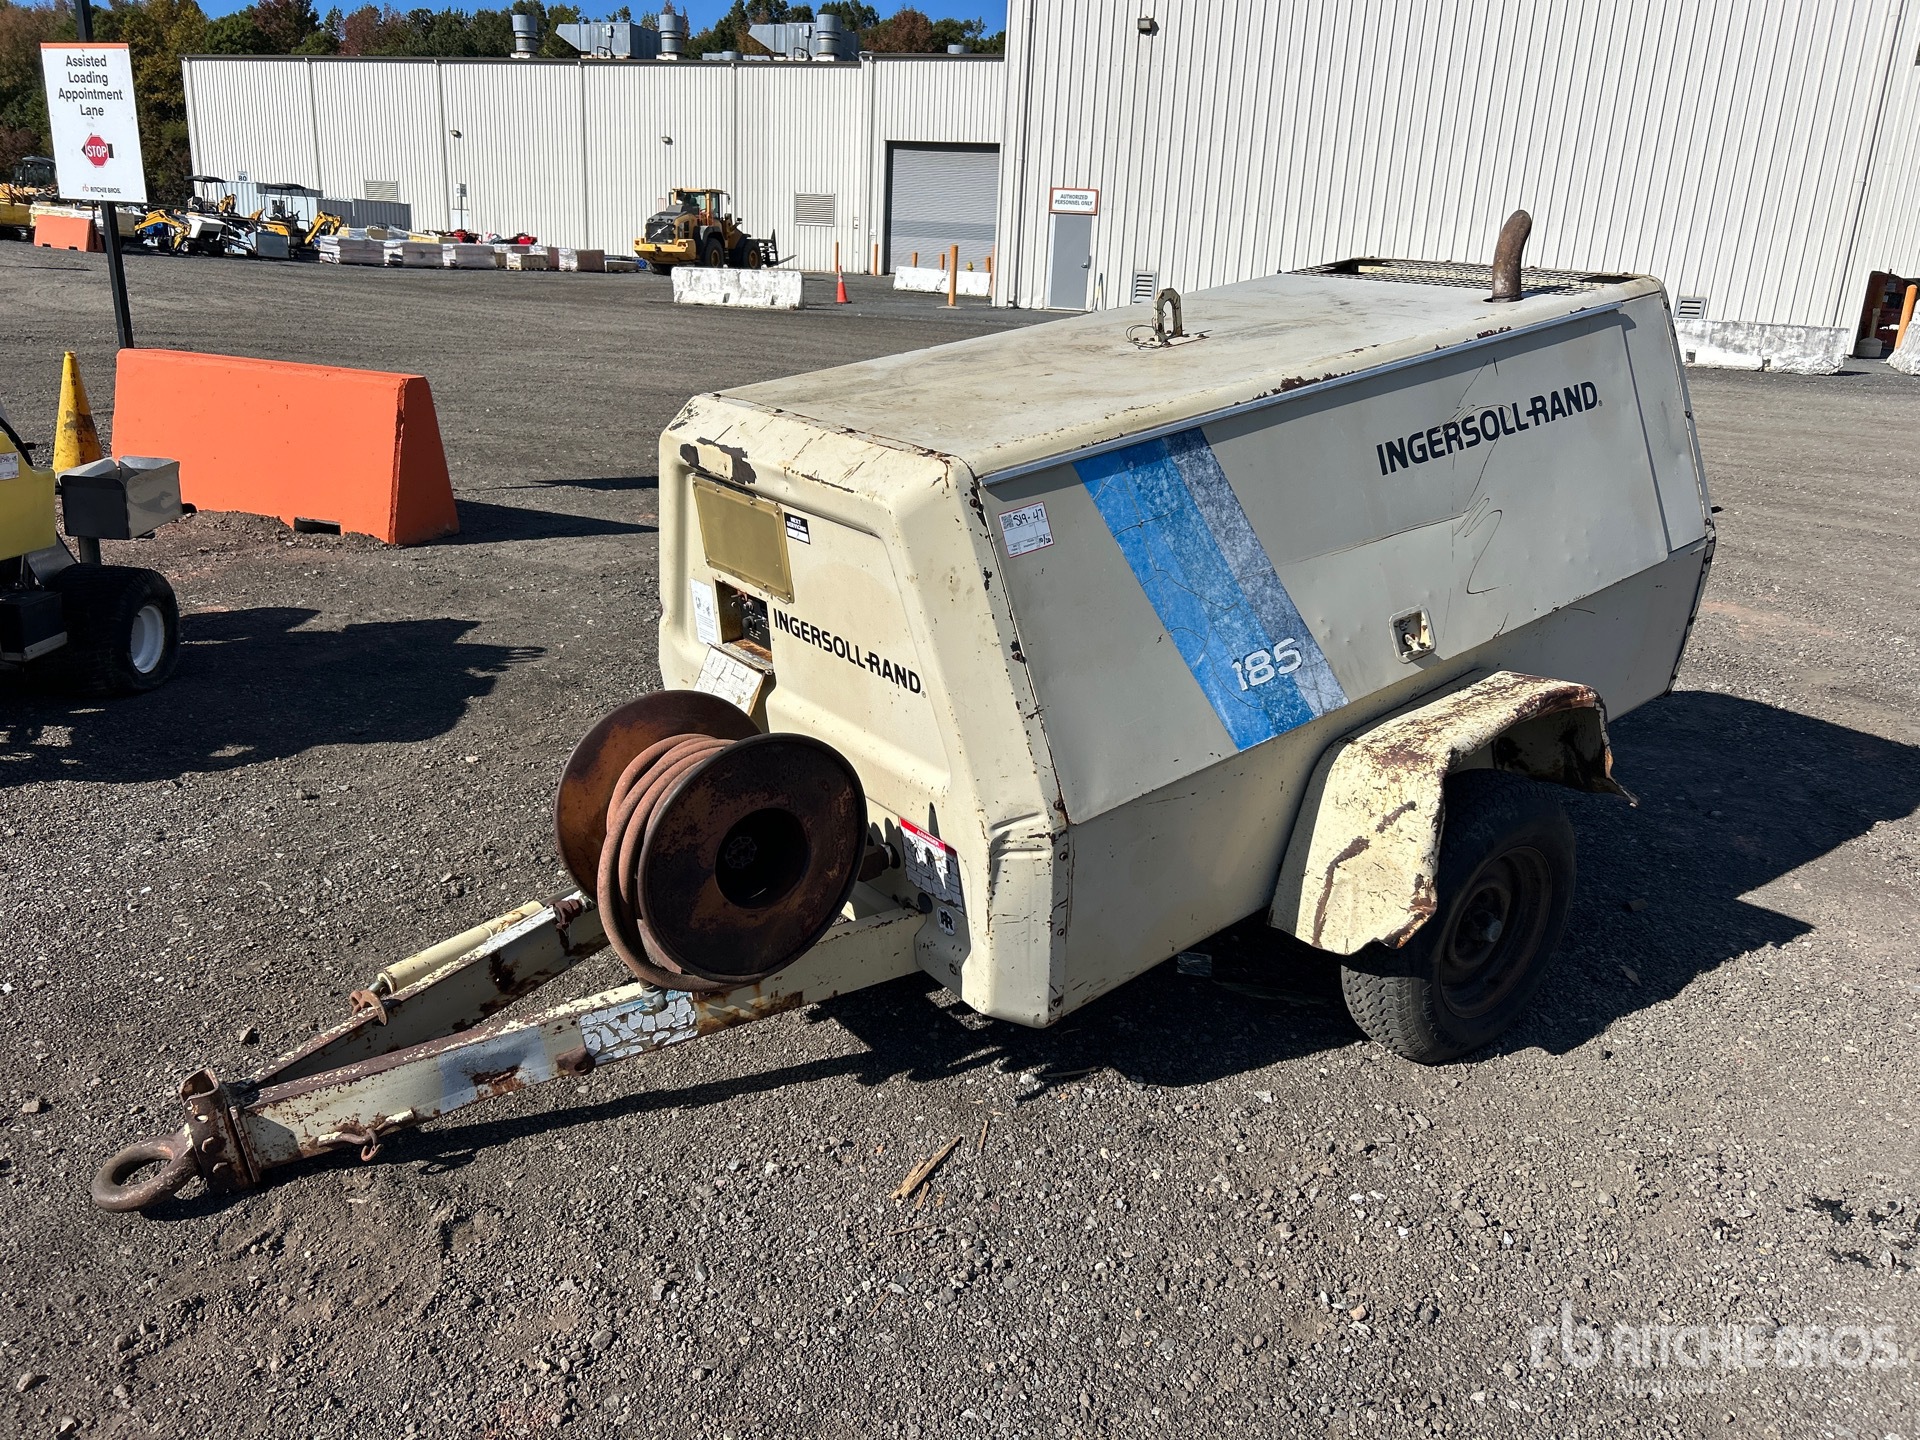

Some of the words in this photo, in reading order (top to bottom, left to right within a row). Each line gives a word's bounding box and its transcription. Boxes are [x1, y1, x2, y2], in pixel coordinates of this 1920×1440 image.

[65, 55, 107, 67] Assisted
[68, 71, 108, 86] Loading
[58, 88, 123, 102] Appointment
[80, 104, 104, 116] Lane
[87, 144, 107, 157] STOP
[1376, 381, 1599, 476] INGERSOLL-RAND
[773, 608, 921, 694] INGERSOLL-RAND
[1231, 637, 1302, 691] 185
